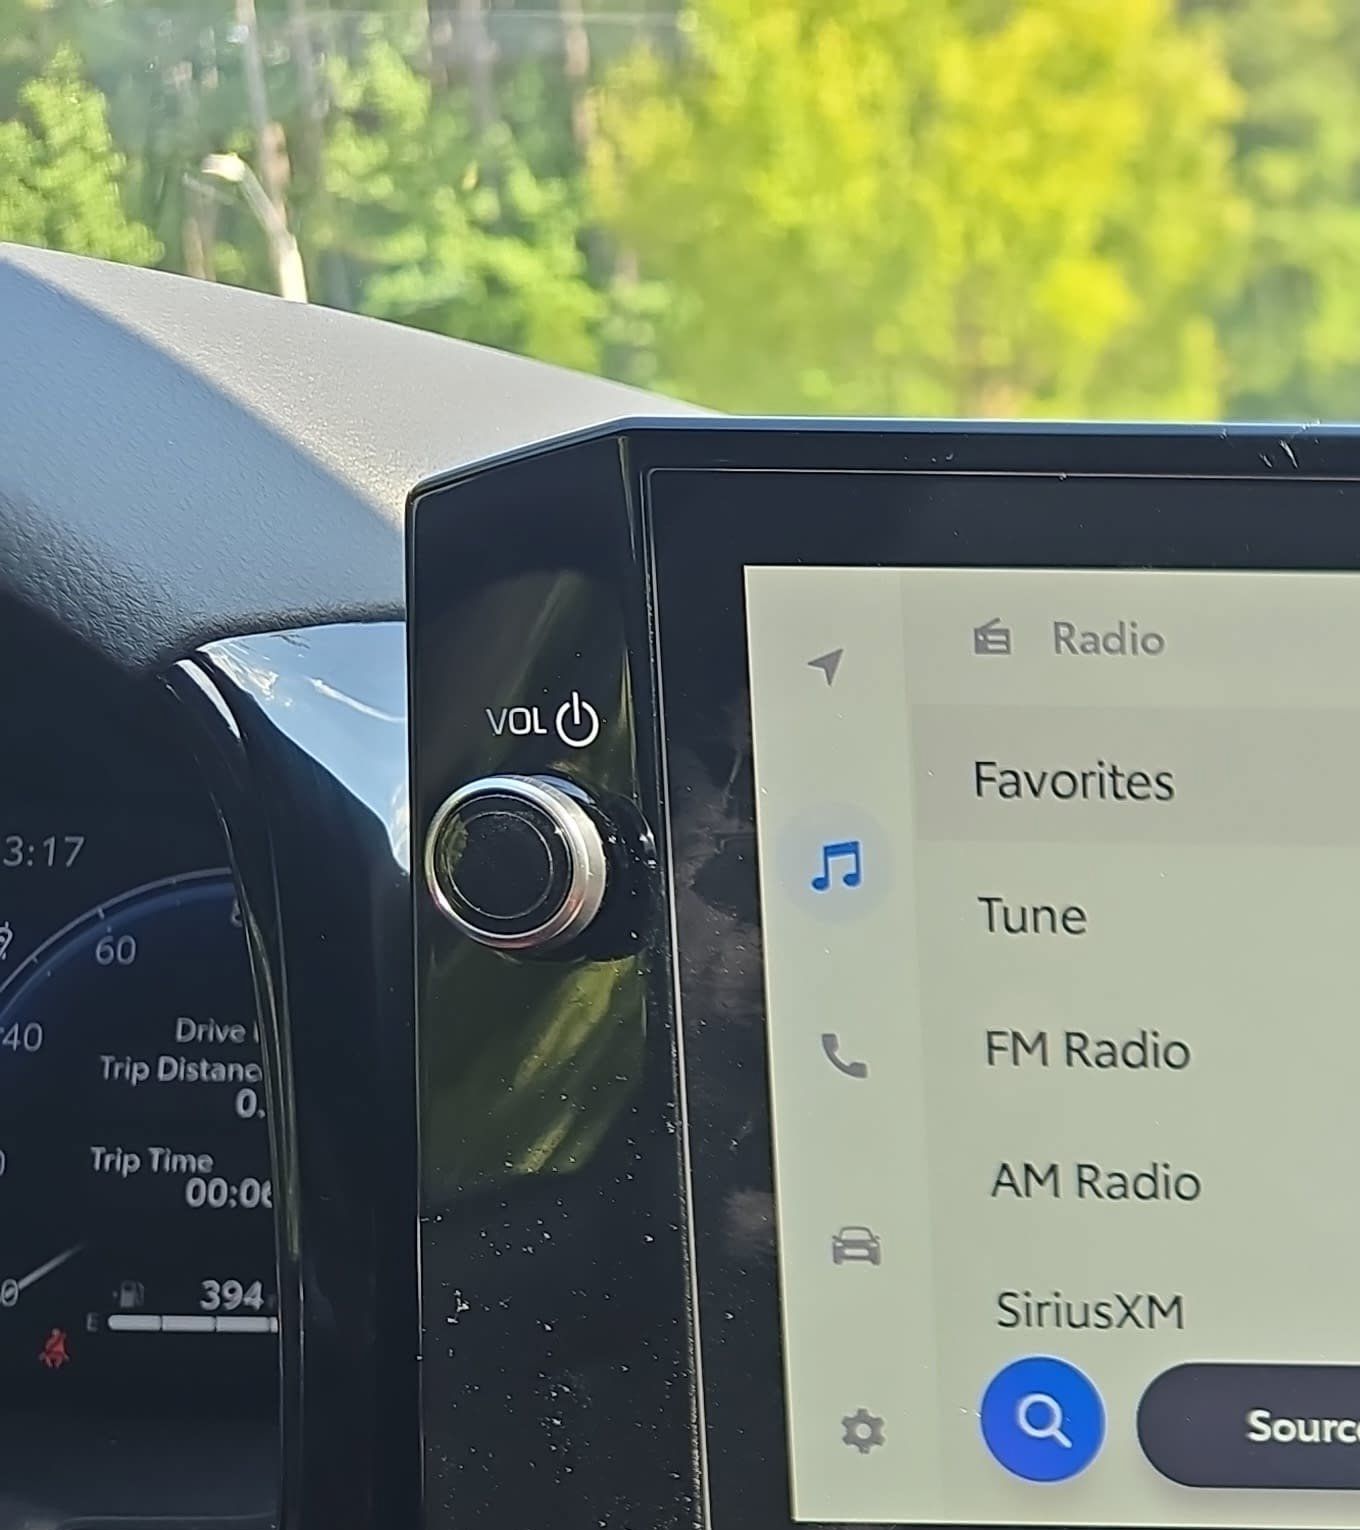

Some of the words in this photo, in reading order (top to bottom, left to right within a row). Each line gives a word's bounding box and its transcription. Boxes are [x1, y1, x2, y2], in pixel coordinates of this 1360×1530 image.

[1054, 621, 1166, 657] Radio
[485, 706, 548, 735] VOL
[974, 760, 1176, 801] Favorites
[3, 835, 85, 867] 3:17
[978, 897, 1087, 936] Tune
[96, 934, 136, 966] 60
[2, 1021, 43, 1052] 40
[175, 1017, 246, 1043] Drive
[986, 1030, 1047, 1068] FM
[1065, 1031, 1191, 1070] Radio
[100, 1055, 150, 1087] Trip
[157, 1055, 263, 1082] Distanc
[91, 1146, 141, 1178] Trip
[148, 1147, 214, 1173] Time
[991, 1163, 1059, 1199] AM
[1077, 1163, 1202, 1202] Radio
[200, 1279, 264, 1311] 394
[997, 1291, 1185, 1330] SiriusXM
